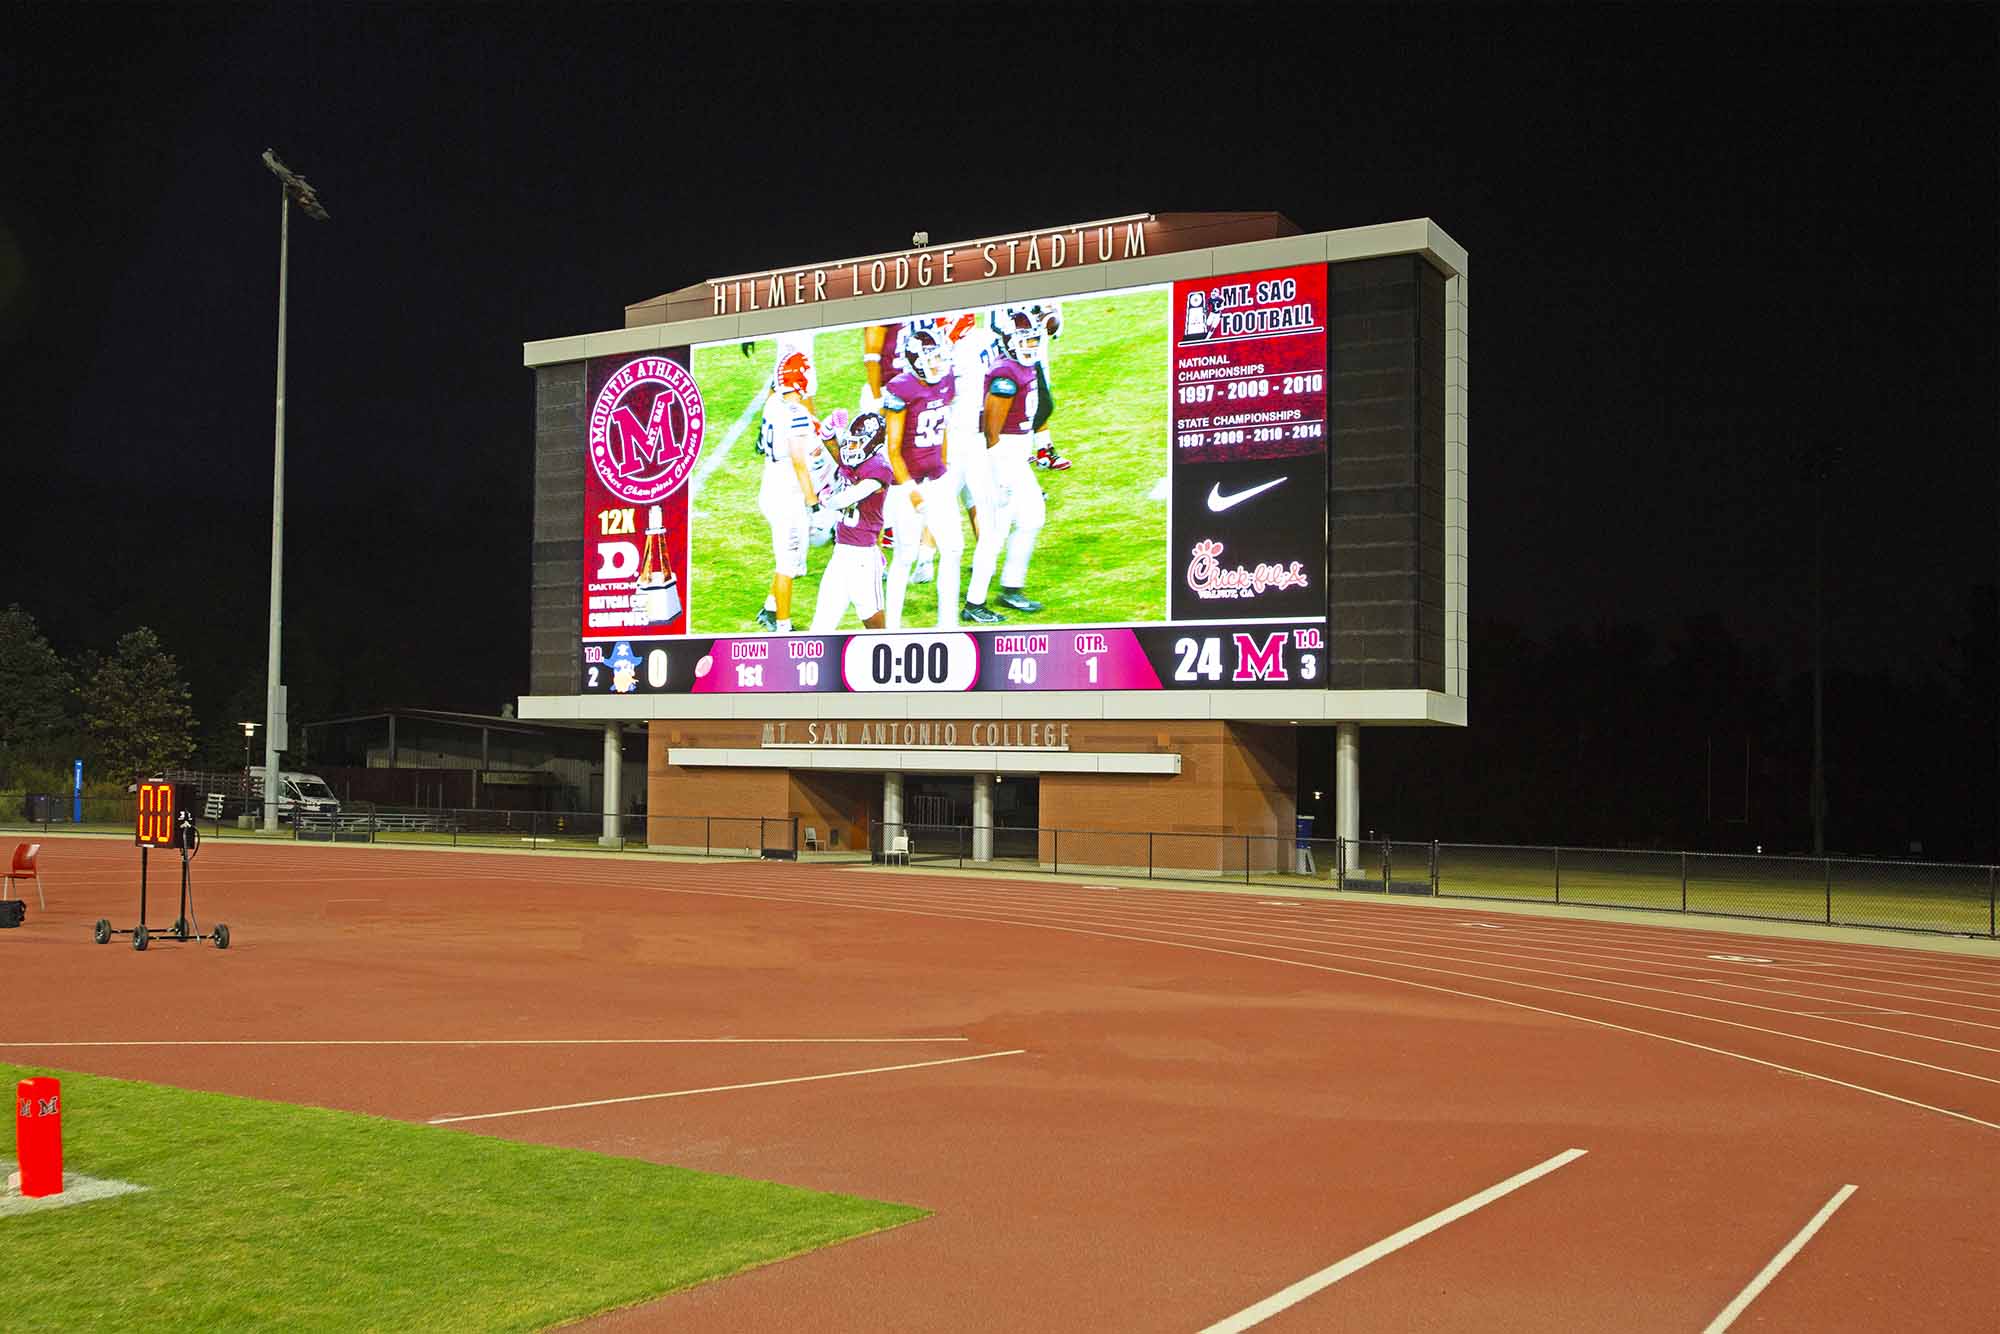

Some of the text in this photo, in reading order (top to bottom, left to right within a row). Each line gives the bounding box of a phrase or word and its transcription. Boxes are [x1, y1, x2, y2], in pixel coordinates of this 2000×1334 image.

[714, 221, 1146, 314] HILMER LODGE STADIUM
[1221, 278, 1296, 308] MT. SAC
[1221, 304, 1314, 335] FOOTBALL
[1178, 354, 1230, 368] NATIONAL
[1178, 364, 1265, 381] CHAMPIONSHIPS
[1178, 384, 1214, 404] 1997
[1227, 379, 1269, 400] 2009
[1283, 374, 1323, 395] 2010
[592, 360, 701, 444] MOUNTIE ATHLETICS
[1177, 409, 1302, 430] STATE CHAMPIONSHIPS
[610, 388, 684, 478] M
[1177, 433, 1204, 448] 1997
[1253, 427, 1283, 442] 2010
[1292, 423, 1322, 439] 2014
[598, 508, 636, 536] 12X
[588, 582, 641, 591] DAKTRONI
[732, 641, 768, 660] DOWN
[995, 635, 1048, 654] BALL ON
[1075, 634, 1107, 653] QTR.
[1293, 628, 1324, 649] T.O.
[648, 649, 667, 688] 0
[872, 642, 948, 684] 0:00
[1174, 637, 1223, 681] 24
[1232, 632, 1288, 681] M
[1301, 654, 1316, 680] 3
[588, 666, 599, 688] 2
[736, 663, 763, 687] 1st
[797, 661, 819, 686] 10
[1008, 658, 1037, 684] 40
[1086, 656, 1098, 683] 1
[808, 722, 847, 745] SAN
[861, 722, 957, 746] ANTONIO
[972, 723, 1070, 747] COLLEGE
[38, 1096, 58, 1117] M
